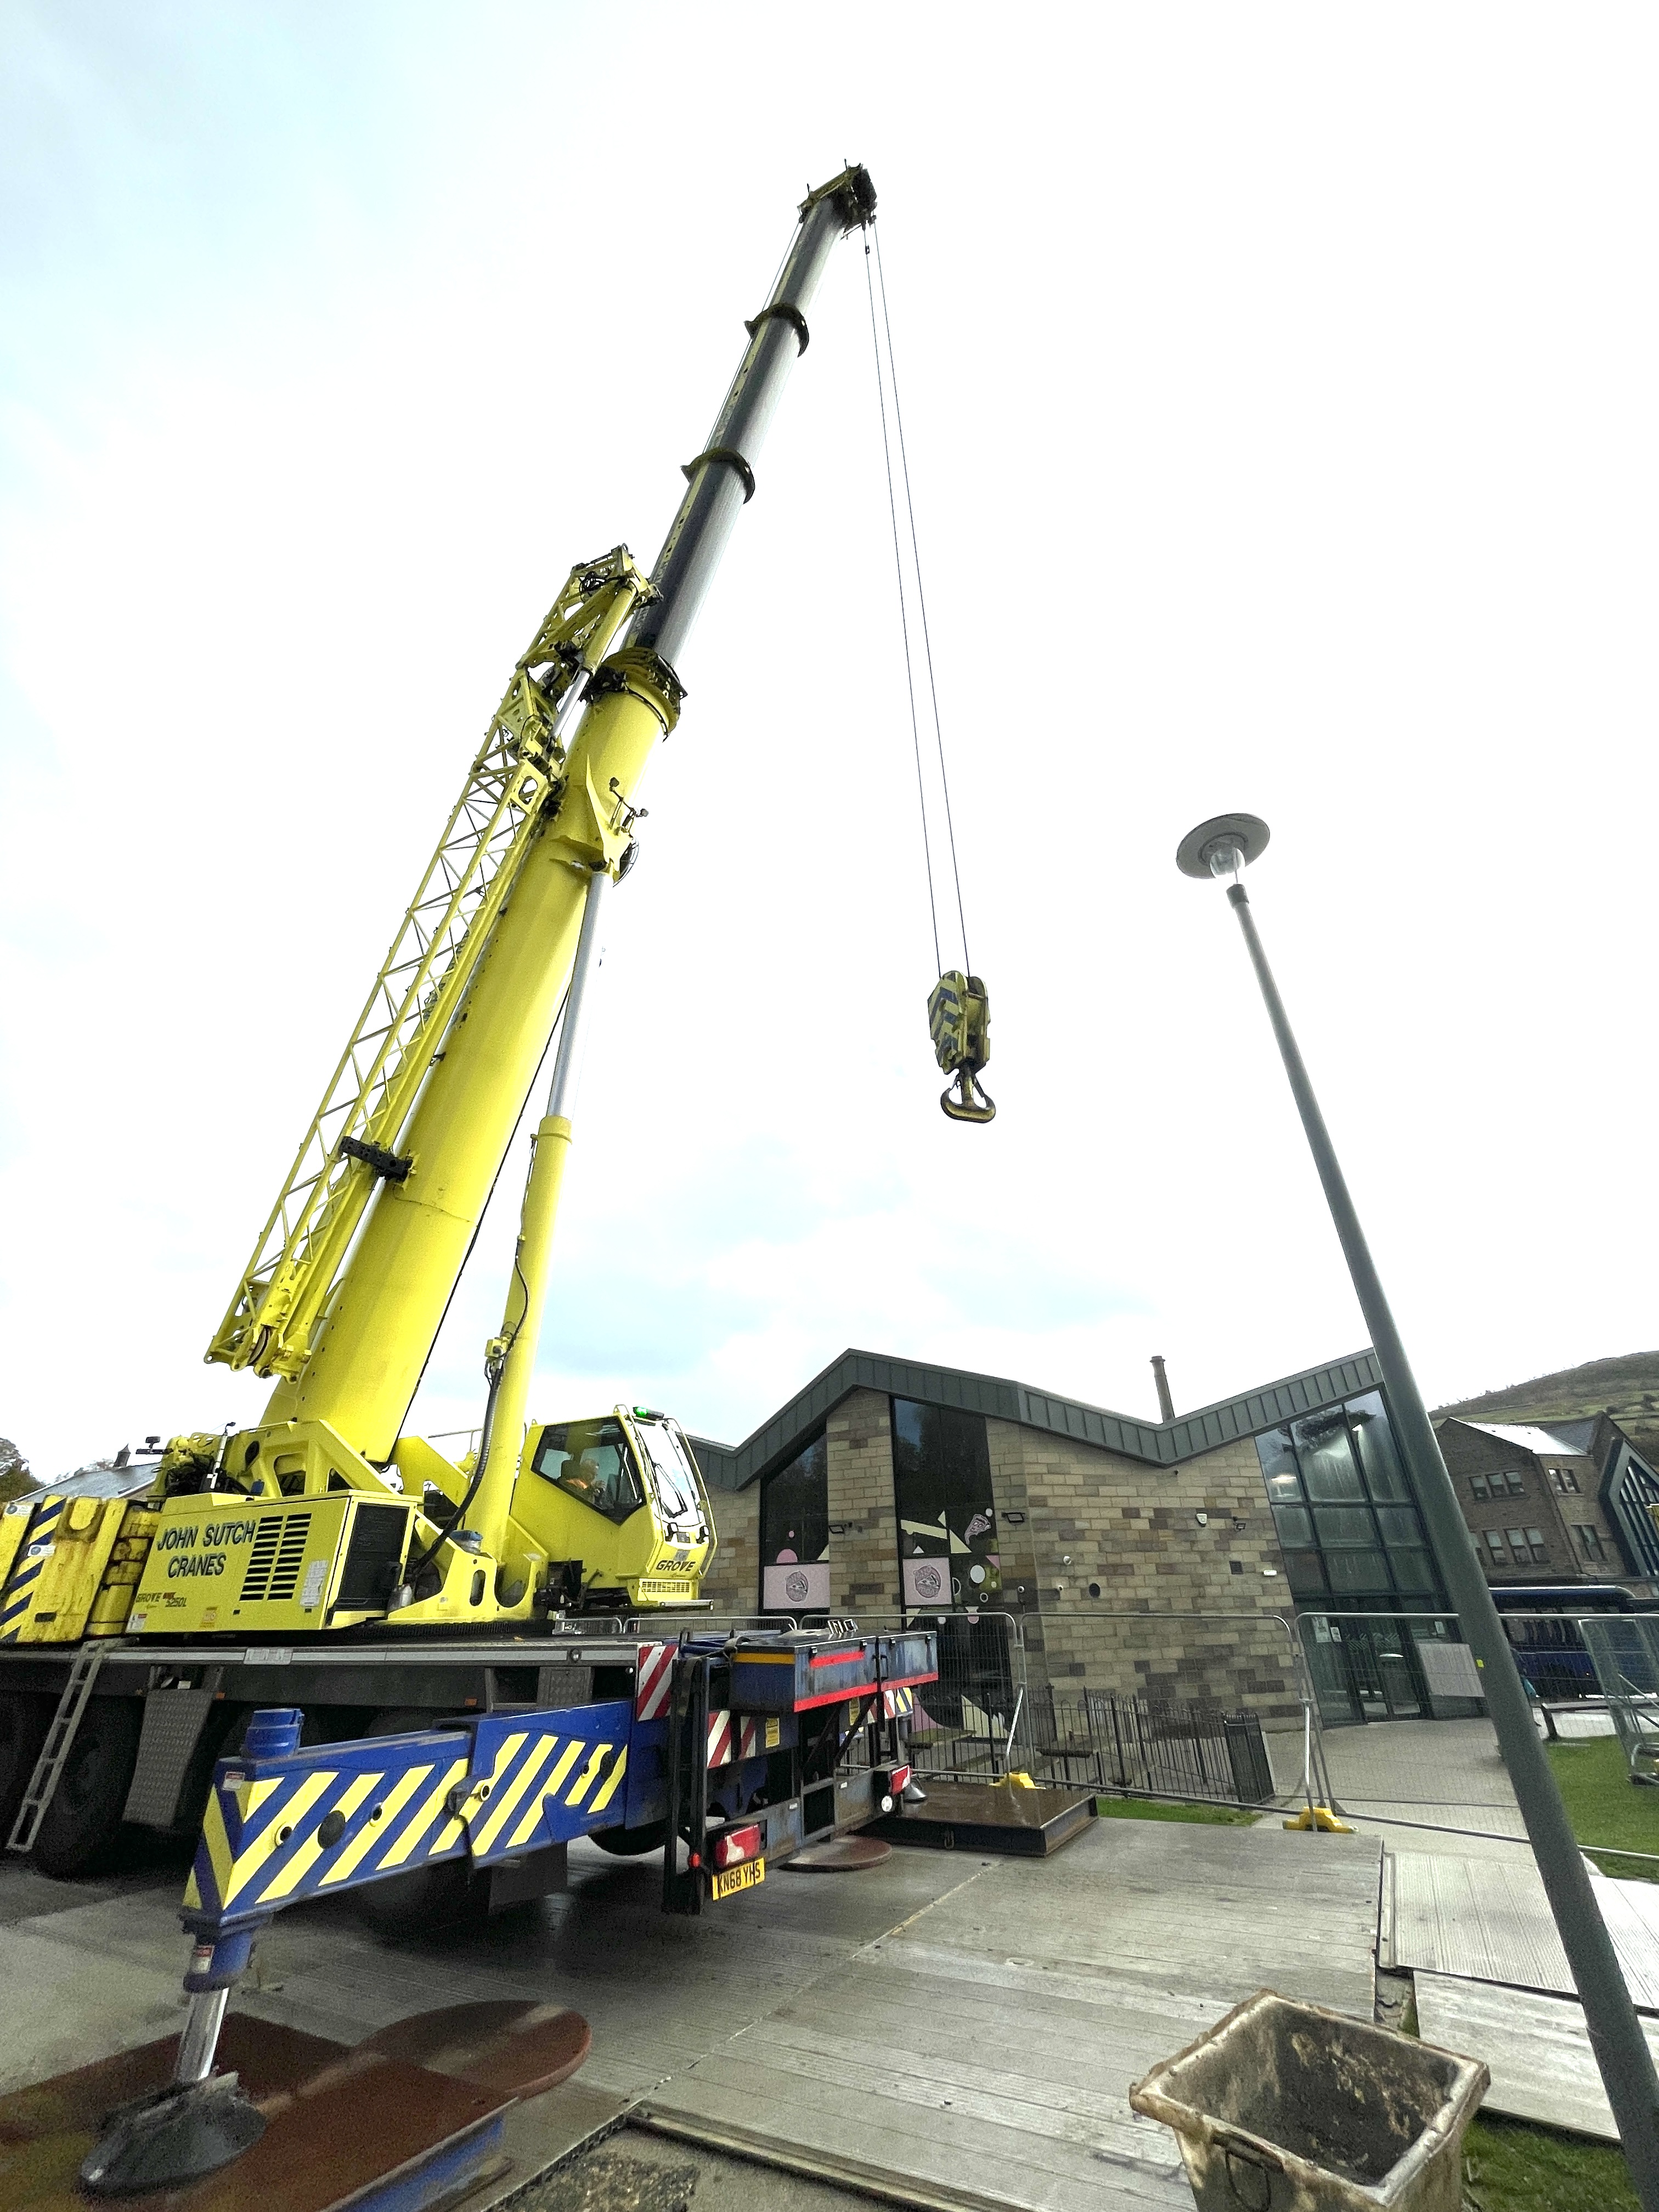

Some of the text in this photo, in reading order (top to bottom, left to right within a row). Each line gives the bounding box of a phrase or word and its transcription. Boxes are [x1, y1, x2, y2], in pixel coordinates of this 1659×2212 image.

[157, 1520, 256, 1551] JOHN SUTCH
[167, 1551, 227, 1578] CRANES
[656, 1560, 696, 1572] GROVE
[719, 1862, 760, 1892] KN68 YHS
